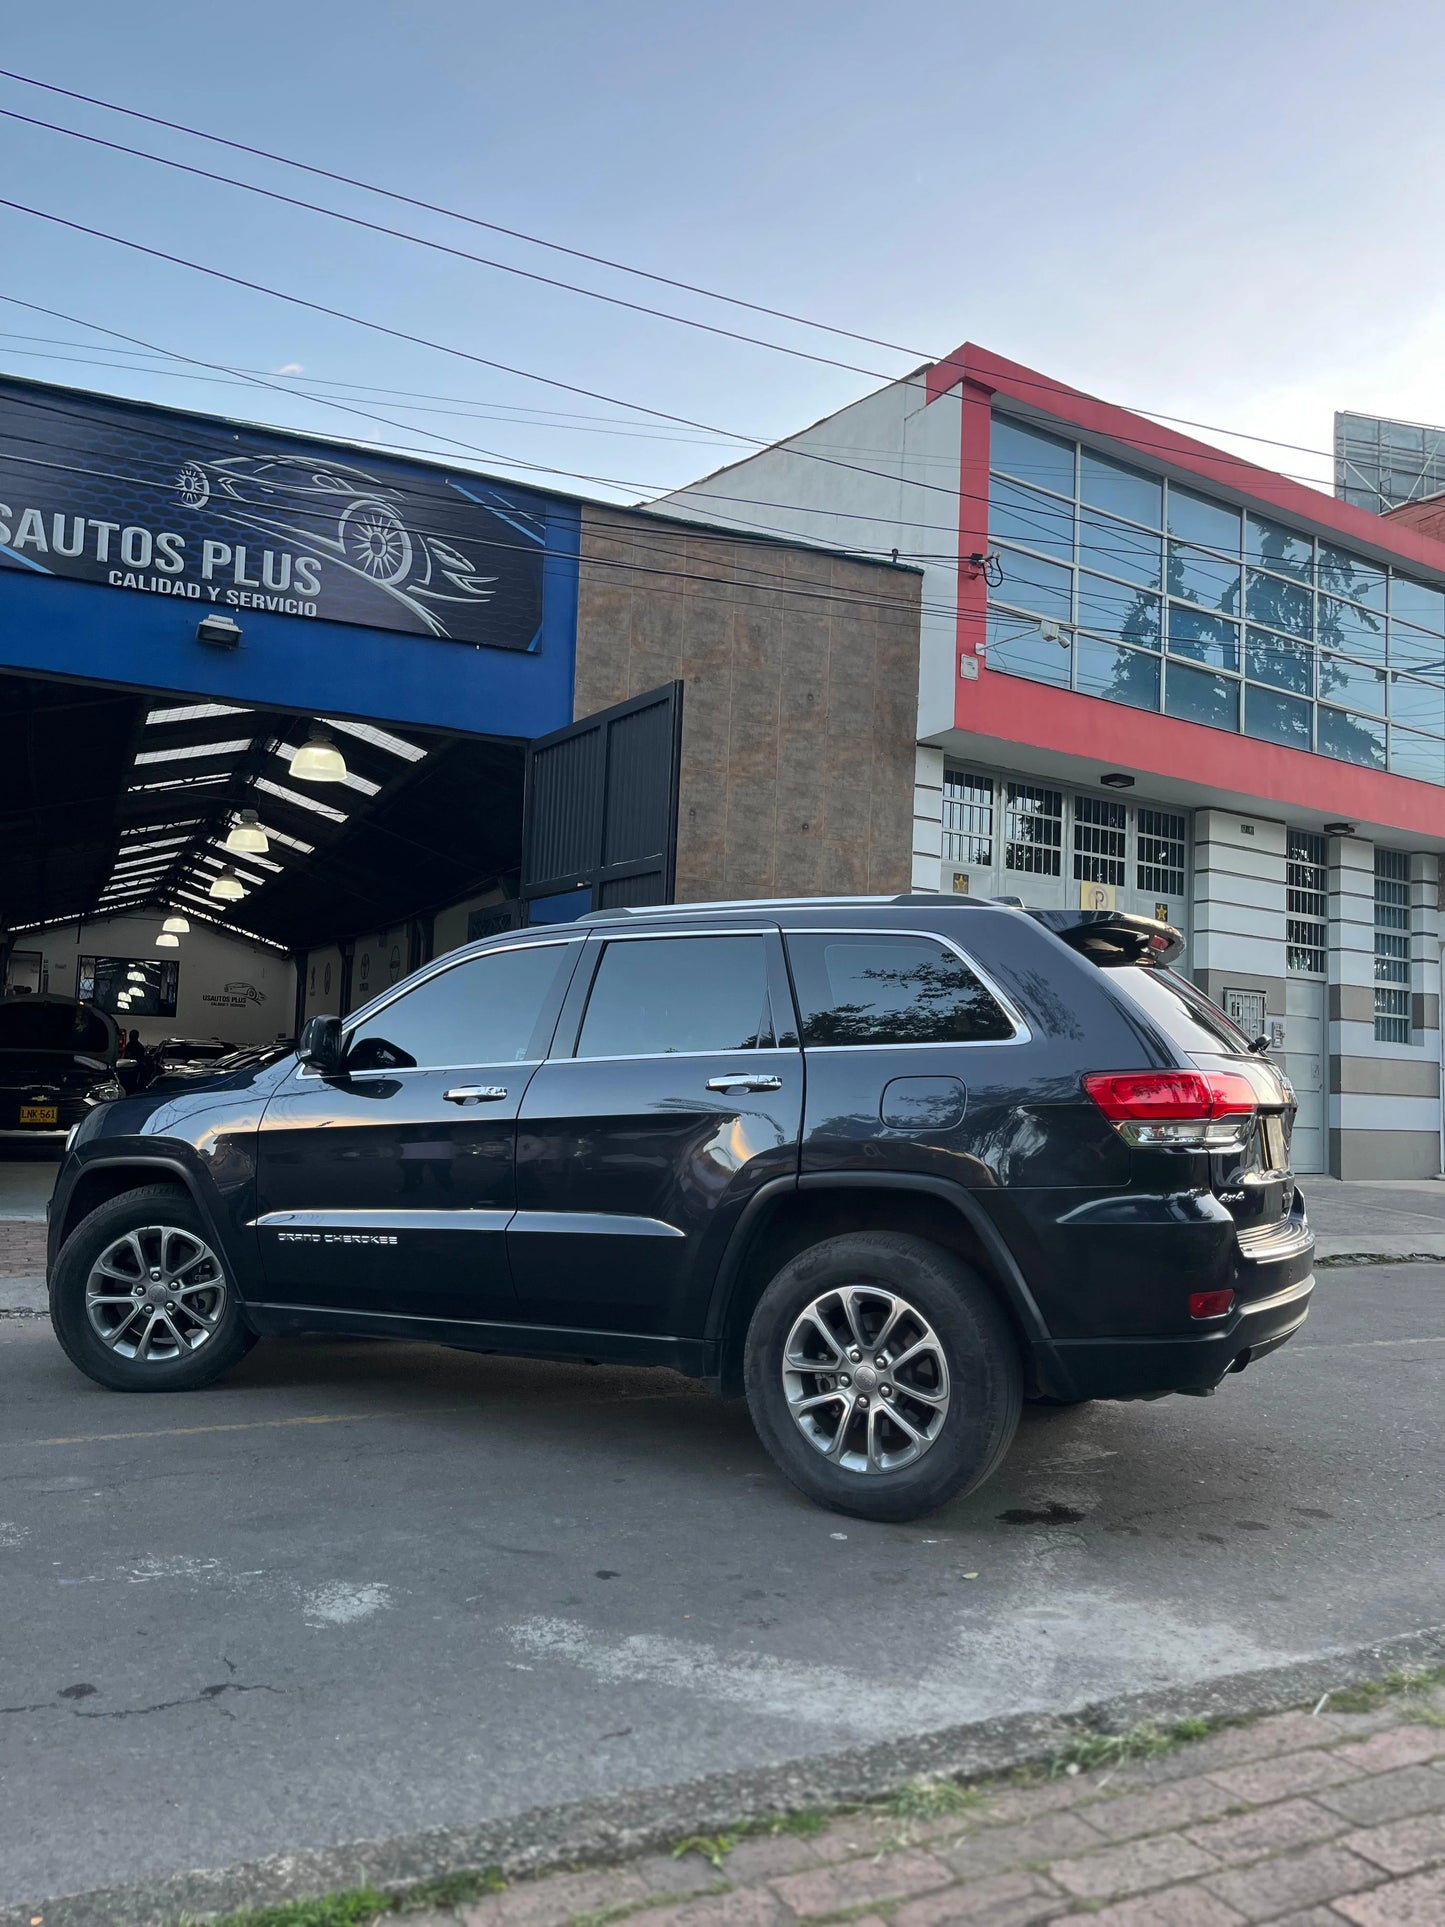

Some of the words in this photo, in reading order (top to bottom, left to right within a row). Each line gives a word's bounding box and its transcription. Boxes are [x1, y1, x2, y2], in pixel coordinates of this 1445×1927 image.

[201, 539, 322, 597] PLUS
[109, 570, 201, 599] CALIDAD
[207, 587, 221, 602] Y
[226, 590, 318, 617] SERVICIO
[231, 996, 247, 1004] PLUS
[278, 1232, 321, 1242] GRAND
[323, 1234, 398, 1245] CHEROKEE
